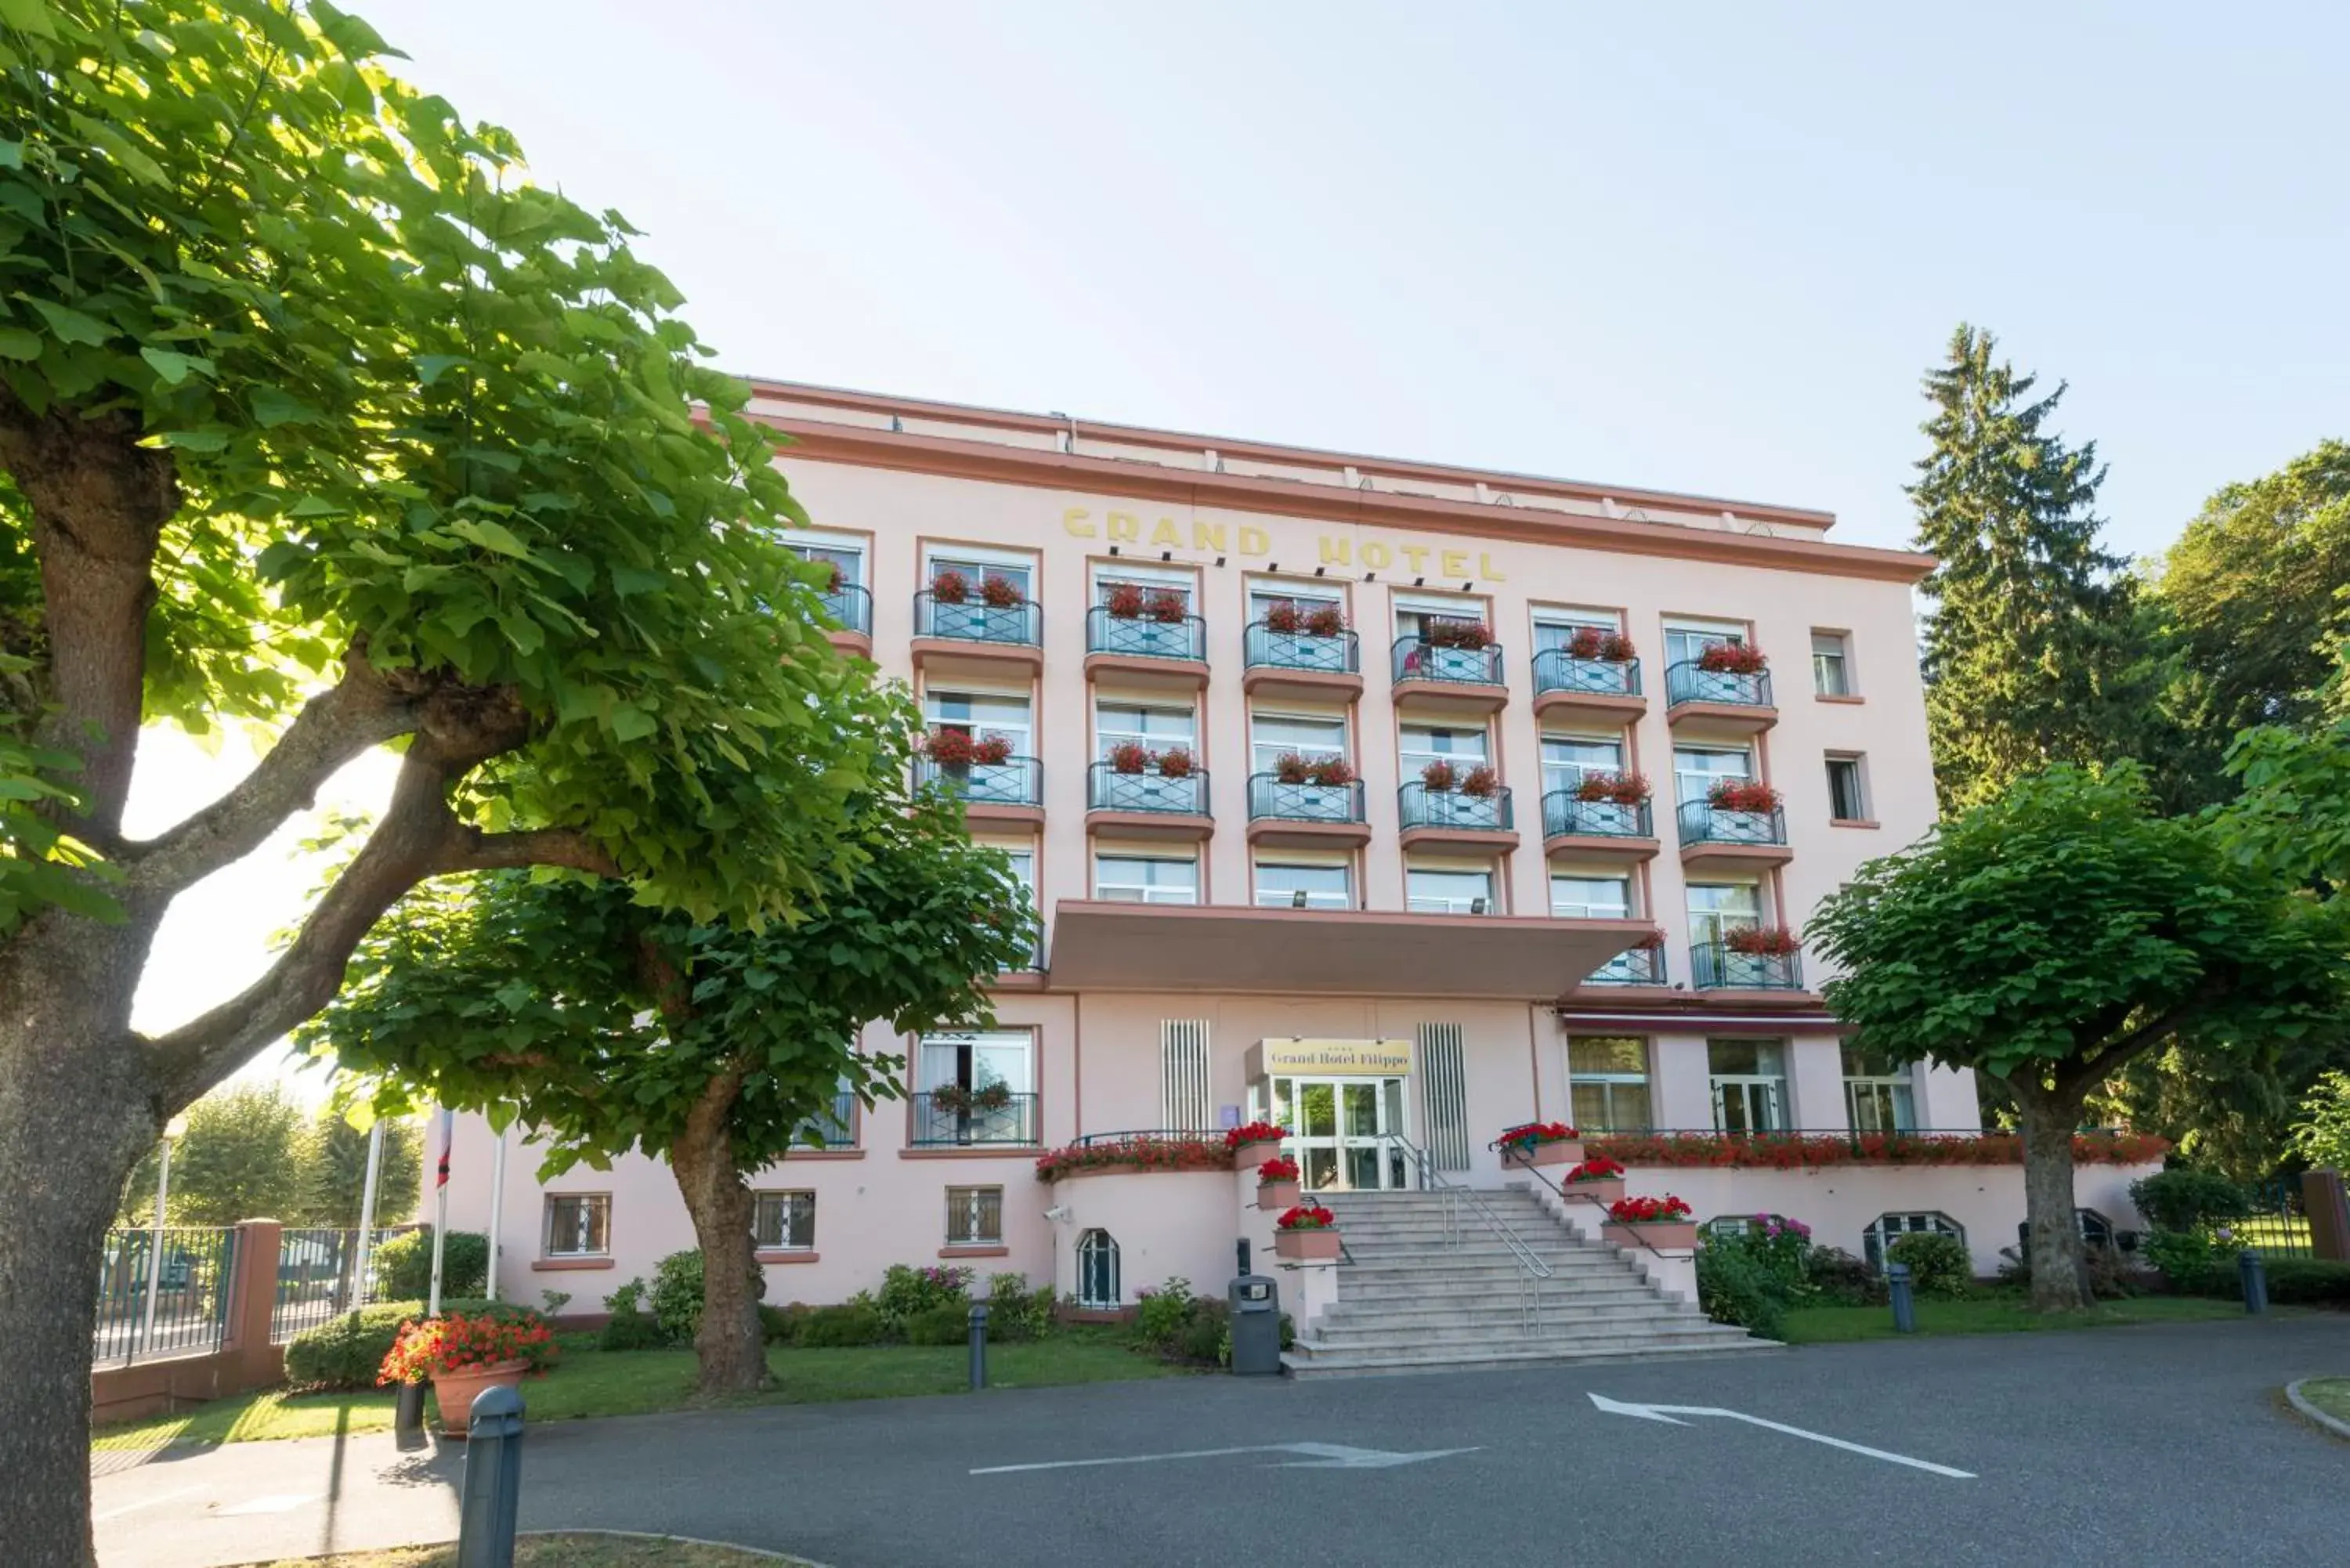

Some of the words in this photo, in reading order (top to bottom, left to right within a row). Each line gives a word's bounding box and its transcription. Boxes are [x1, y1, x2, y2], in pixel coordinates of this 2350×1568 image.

[1063, 508, 1271, 556] GRAND
[1319, 536, 1507, 581] HOTEL
[1271, 1052, 1315, 1065] Grand
[1320, 1052, 1355, 1065] Hotel
[1361, 1053, 1408, 1068] Filippo
